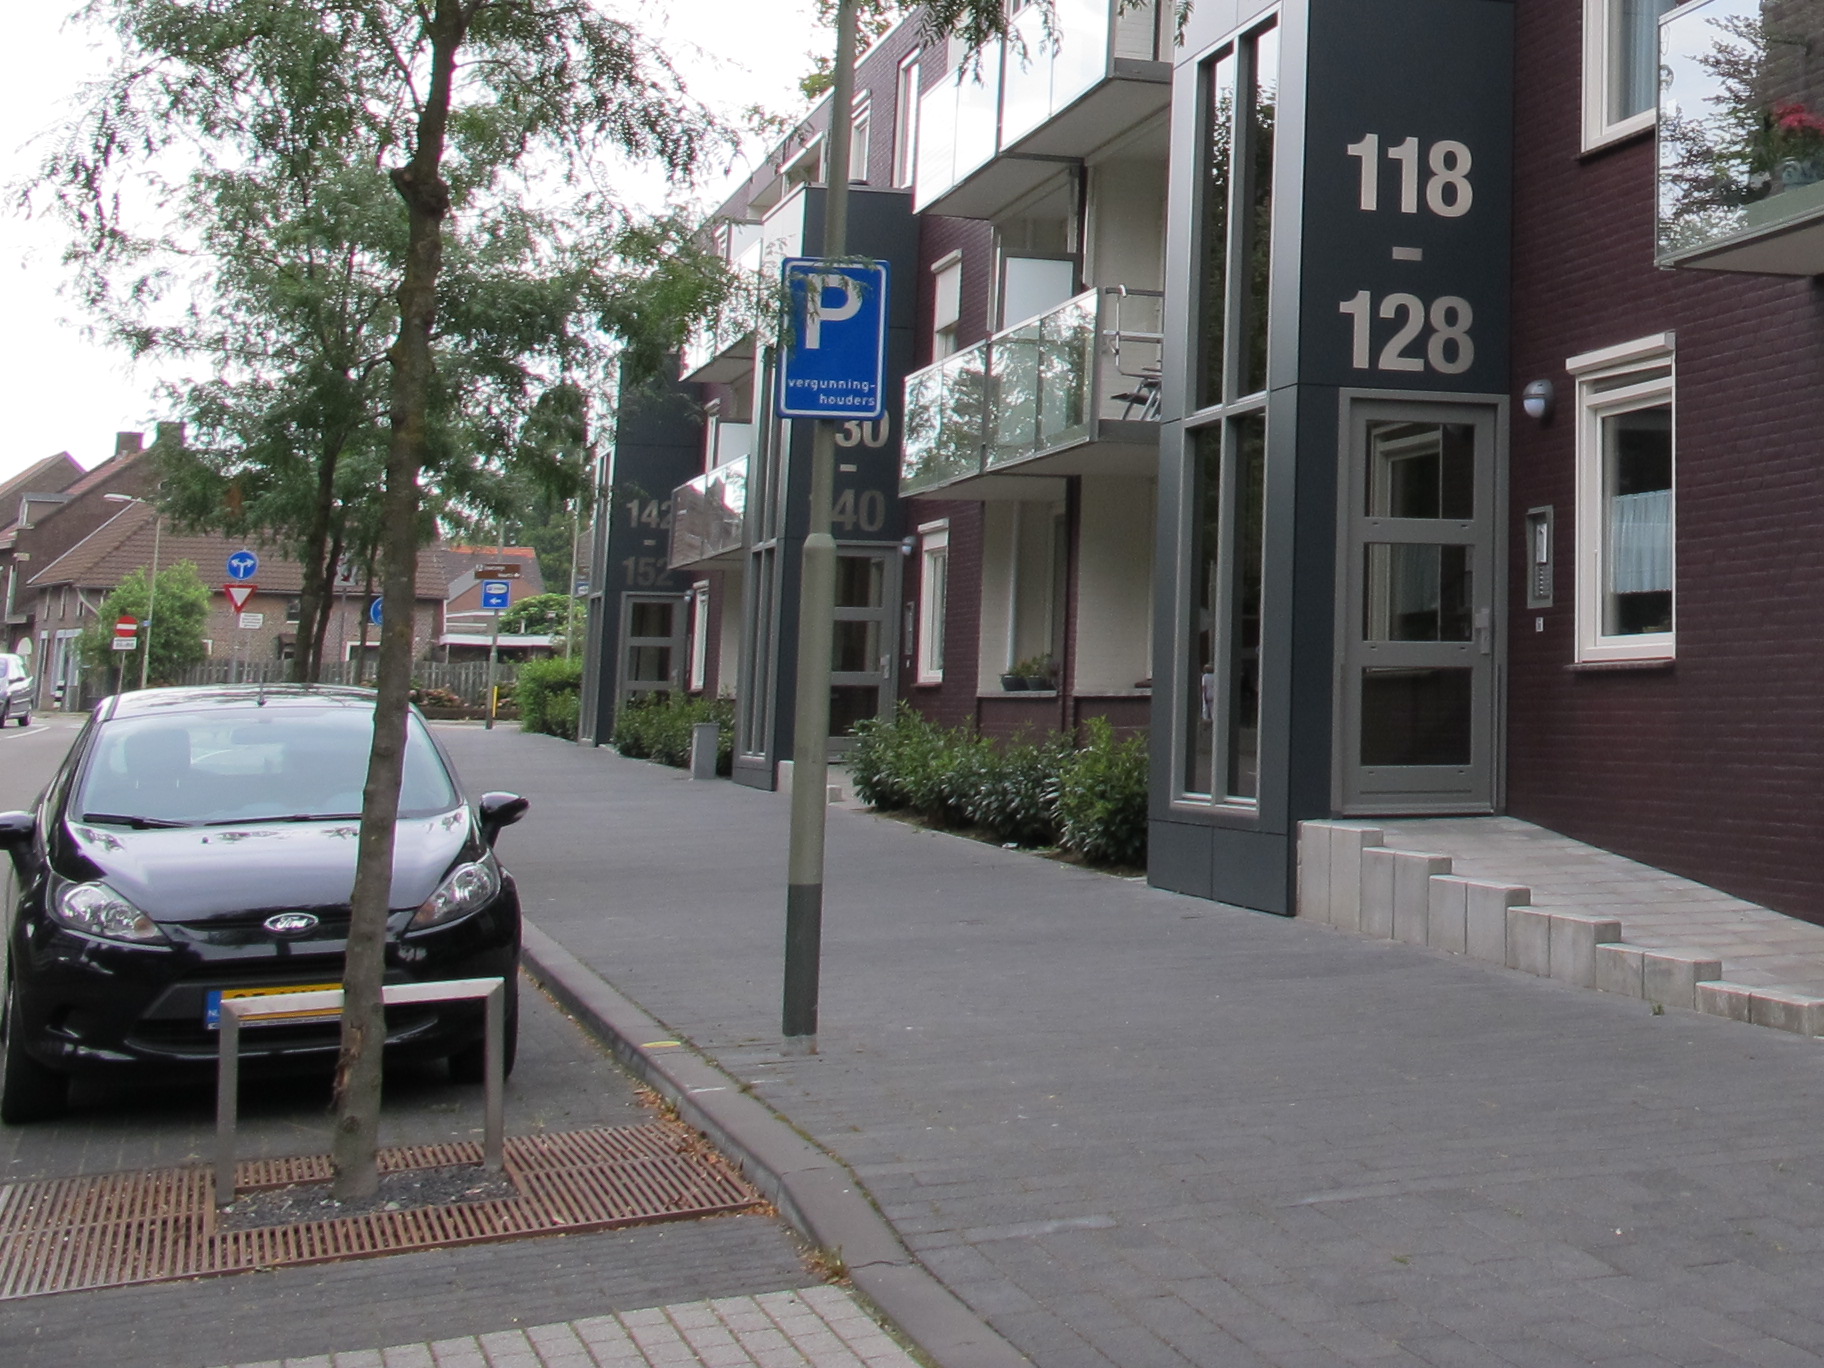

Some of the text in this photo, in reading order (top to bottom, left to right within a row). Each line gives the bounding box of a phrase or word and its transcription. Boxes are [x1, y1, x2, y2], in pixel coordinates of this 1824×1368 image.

[1346, 132, 1474, 218] 118
[805, 273, 863, 350] P
[1338, 290, 1475, 374] 128
[787, 378, 876, 396] vergunning-
[819, 393, 876, 406] houders
[835, 410, 890, 449] 30
[626, 499, 673, 529] 142
[809, 488, 886, 532] 40
[622, 555, 674, 587] 152
[275, 916, 308, 931] Ford
